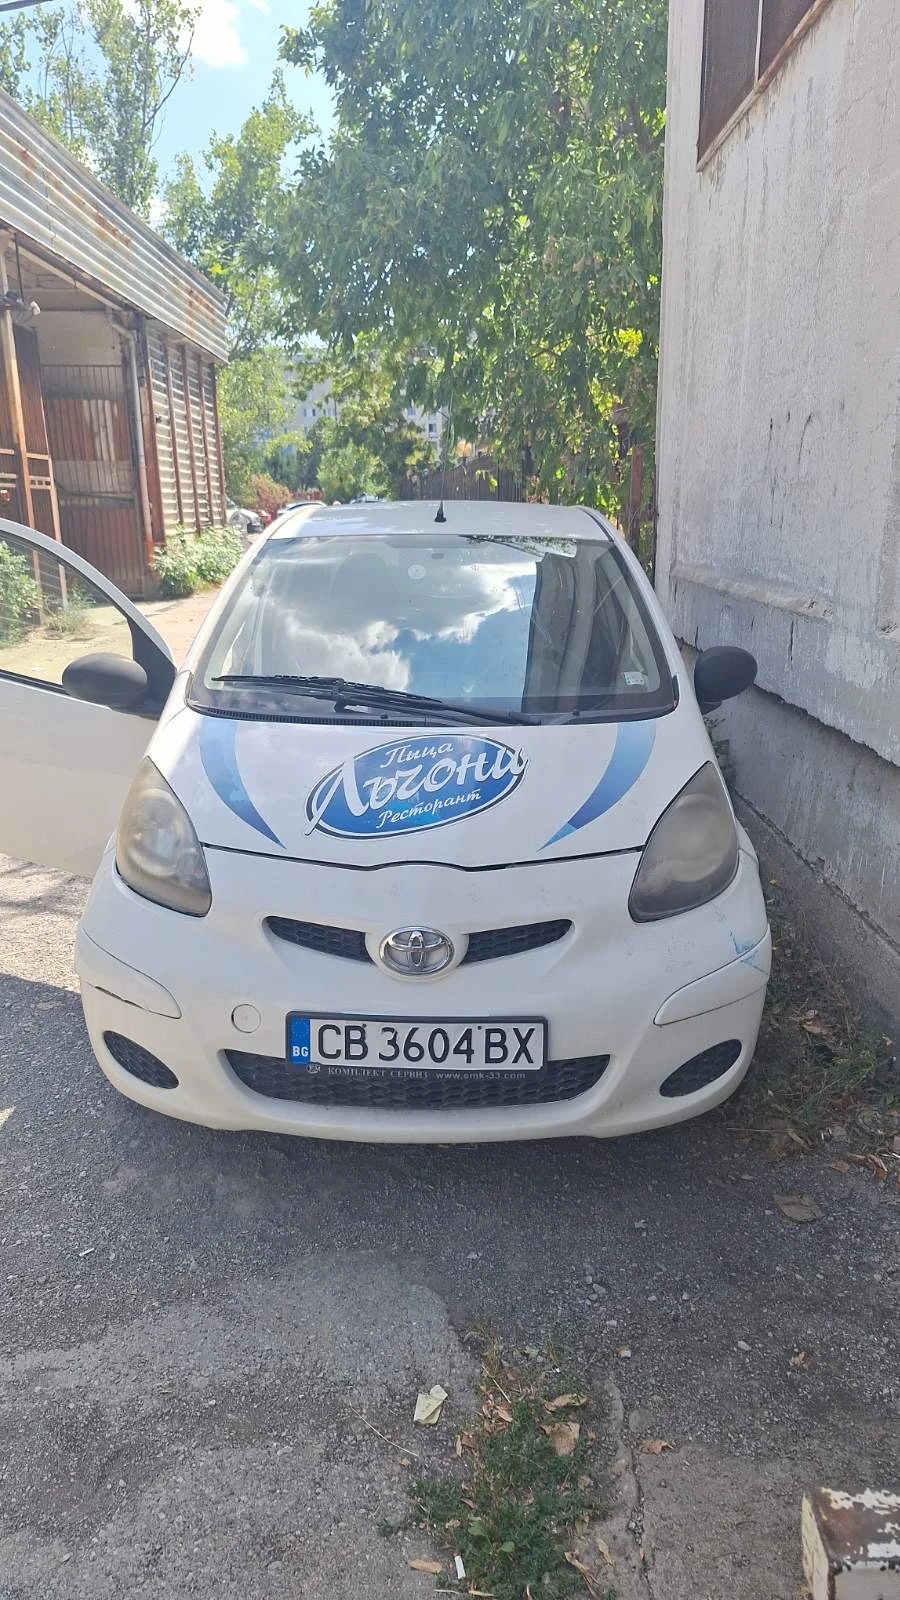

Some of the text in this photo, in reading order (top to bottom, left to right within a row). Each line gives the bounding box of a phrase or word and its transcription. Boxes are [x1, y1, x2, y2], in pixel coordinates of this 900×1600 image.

[380, 742, 454, 768] Пица
[375, 788, 482, 829] Ресторант
[292, 1045, 309, 1057] BG
[378, 1026, 475, 1064] 3604
[328, 1067, 386, 1077] КОМПЛЕКТ
